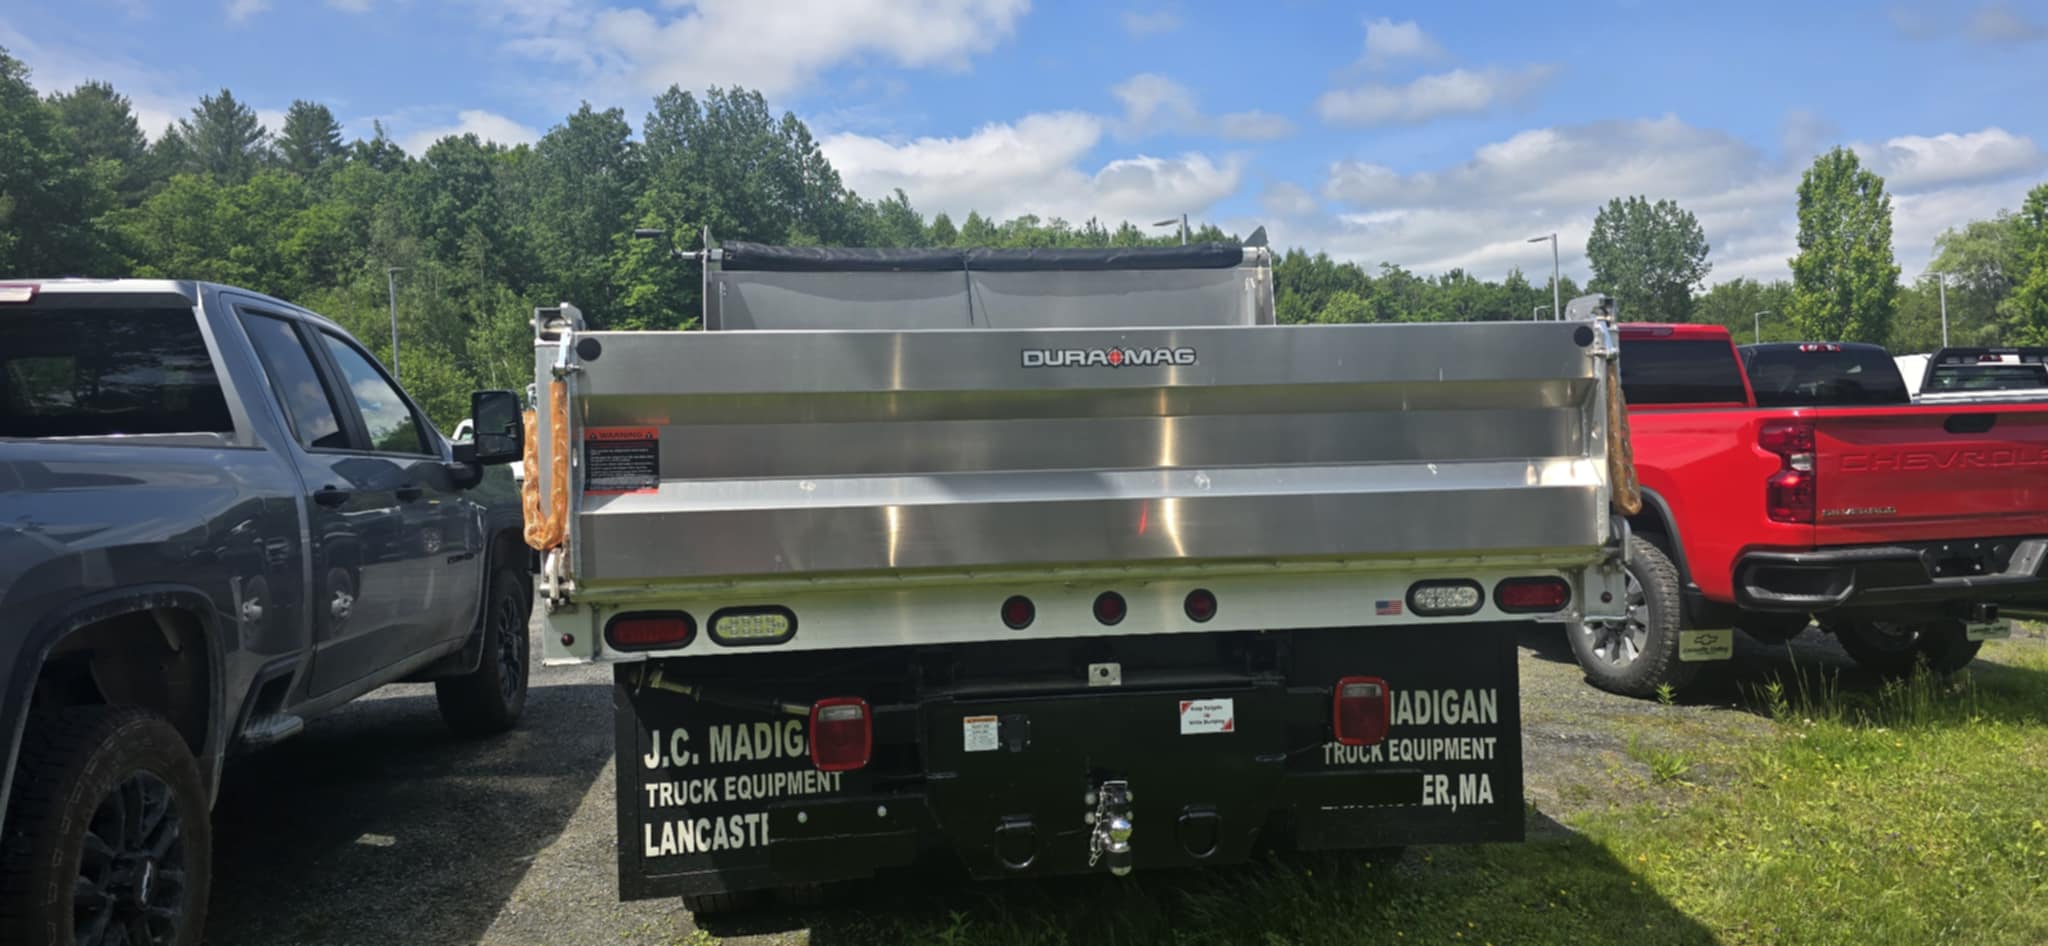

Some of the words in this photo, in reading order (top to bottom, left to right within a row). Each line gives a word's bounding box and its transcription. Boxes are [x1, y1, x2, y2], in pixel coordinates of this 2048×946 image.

[1839, 448, 2048, 473] CHEVROL
[643, 727, 700, 770] J.C.
[709, 719, 810, 764] MADIG
[1321, 741, 1384, 766] TRUCK
[1388, 737, 1497, 763] EQUIPMENT
[644, 777, 719, 809] TRUCK
[724, 769, 844, 801] EQUIPMENT
